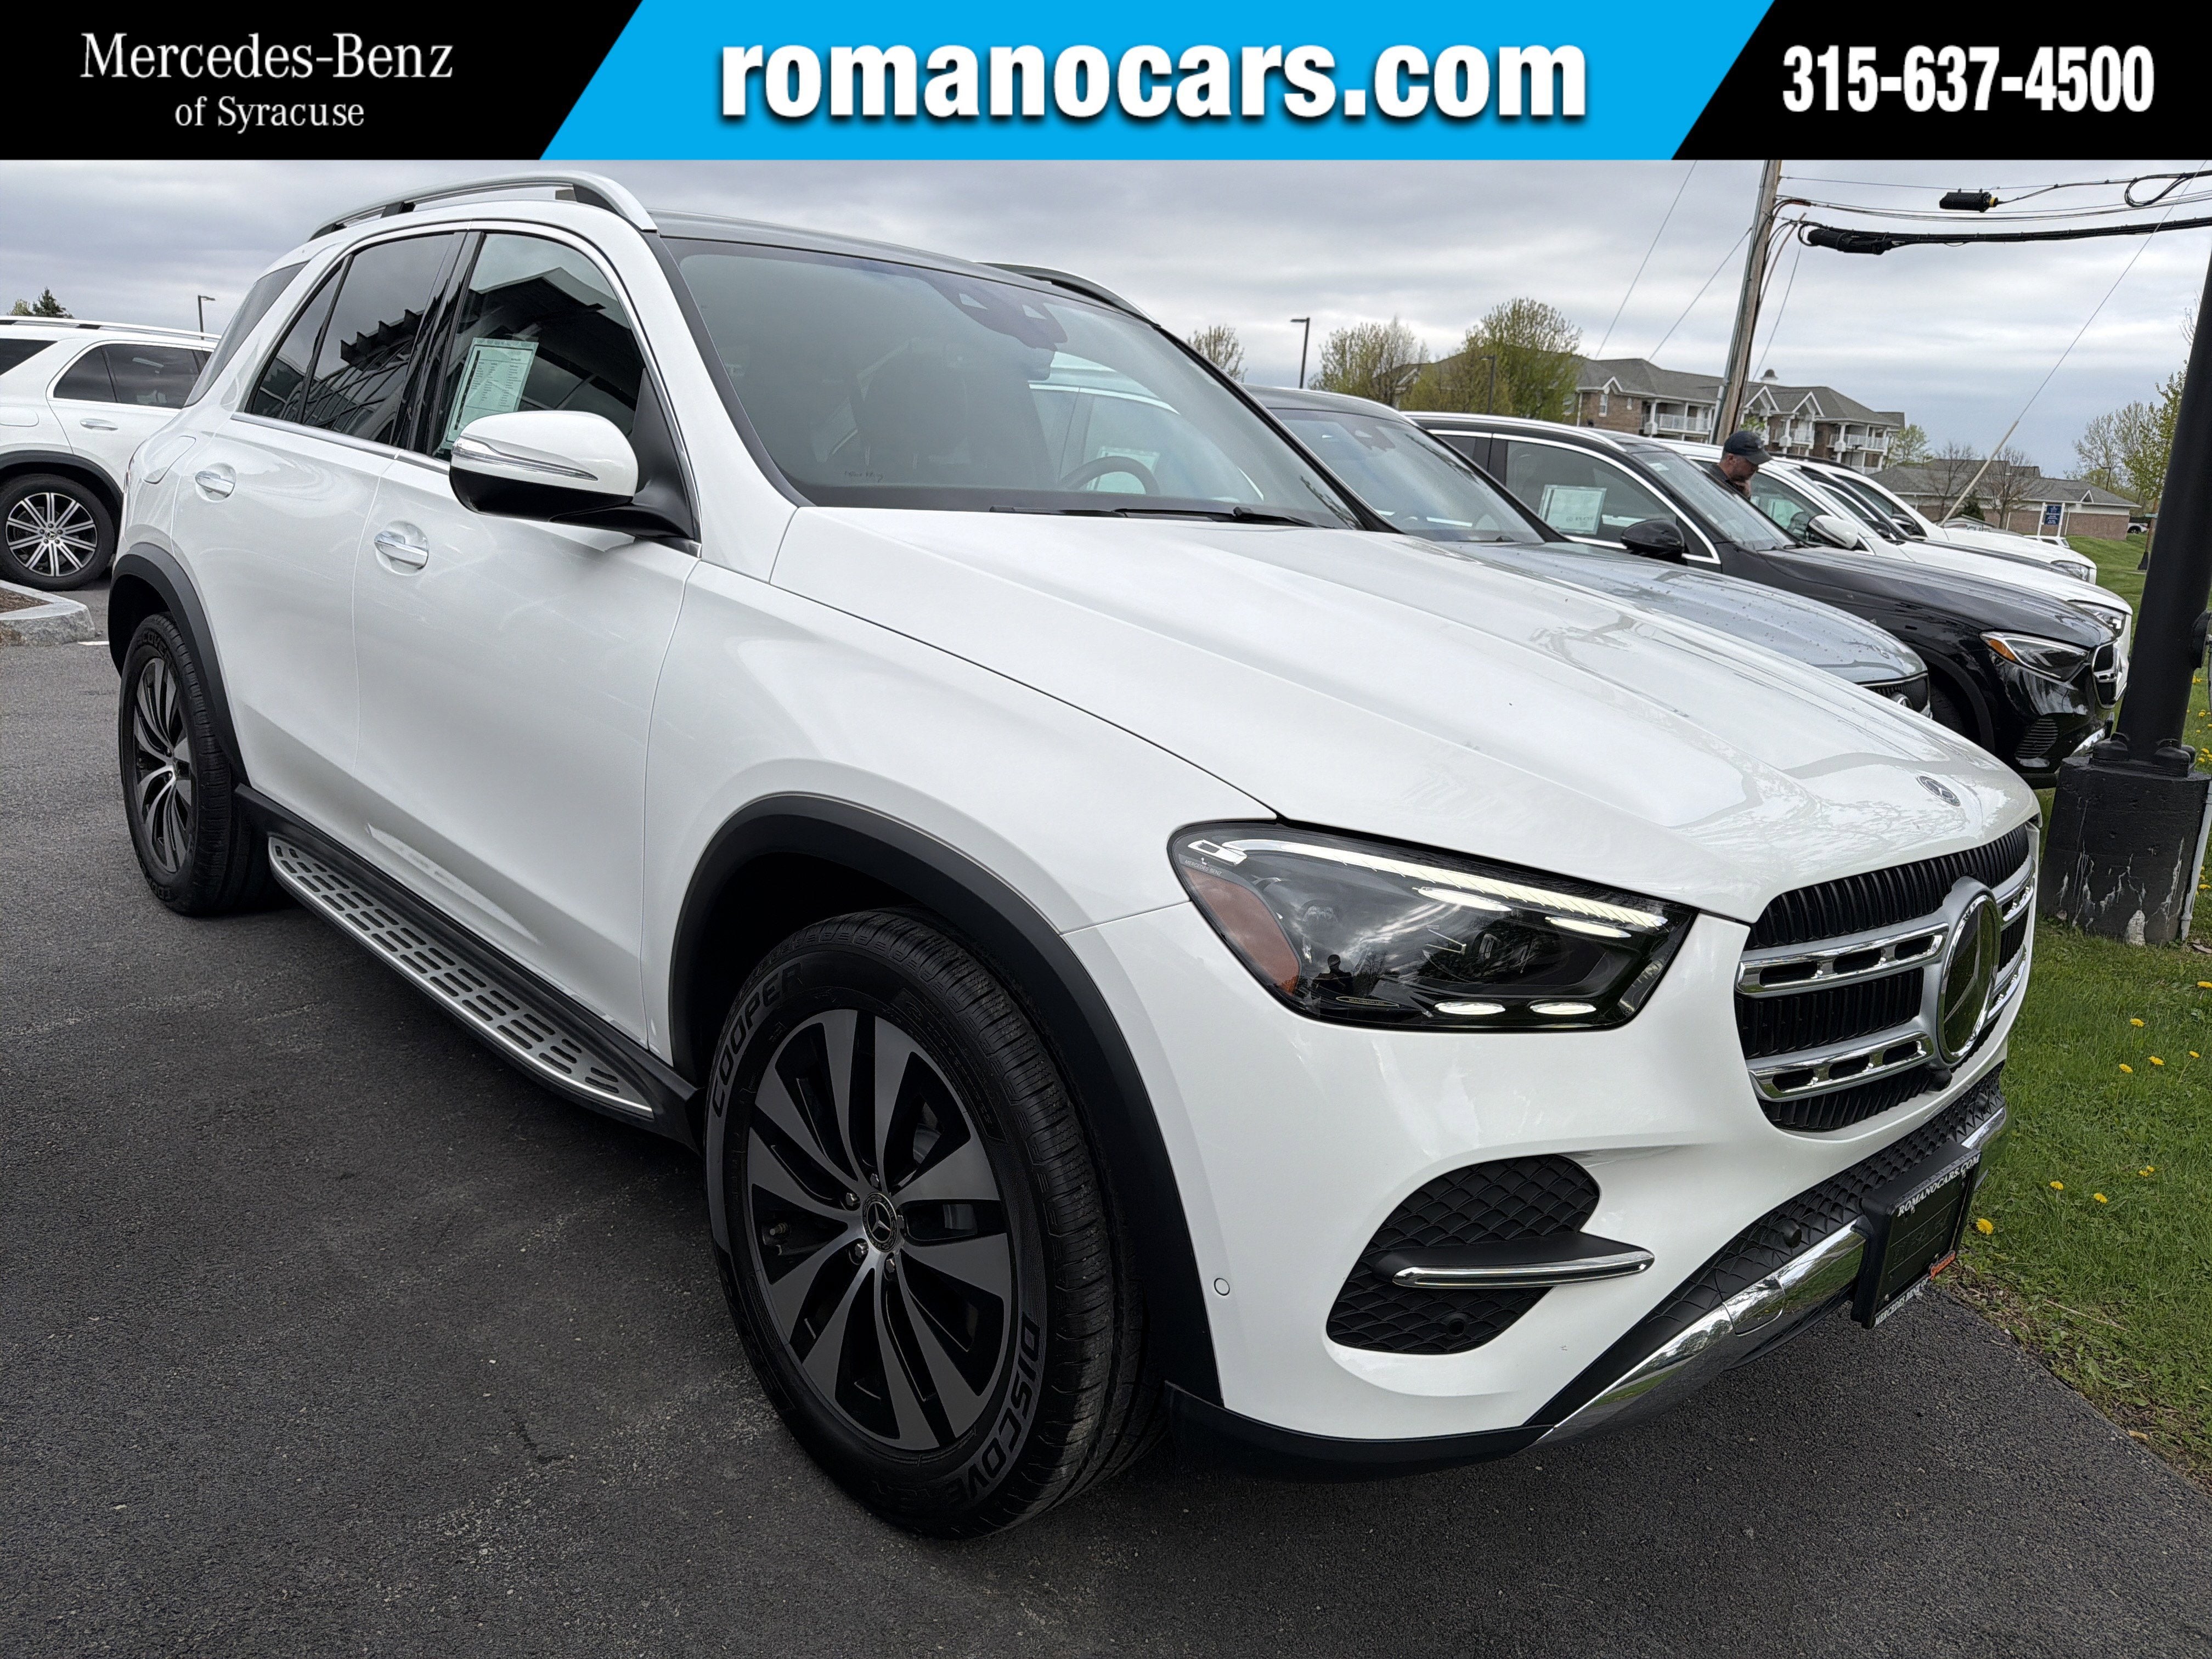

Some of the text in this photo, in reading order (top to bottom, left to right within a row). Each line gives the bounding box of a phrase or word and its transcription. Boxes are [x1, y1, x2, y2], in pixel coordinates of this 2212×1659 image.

[712, 962, 804, 1118] COOPER
[1897, 1153, 1981, 1217] ROMANOCARS.COM
[1874, 1295, 1906, 1327] MERCEDES
[1905, 1282, 1921, 1302] BENZ
[916, 1310, 1041, 1509] DISCOVE
